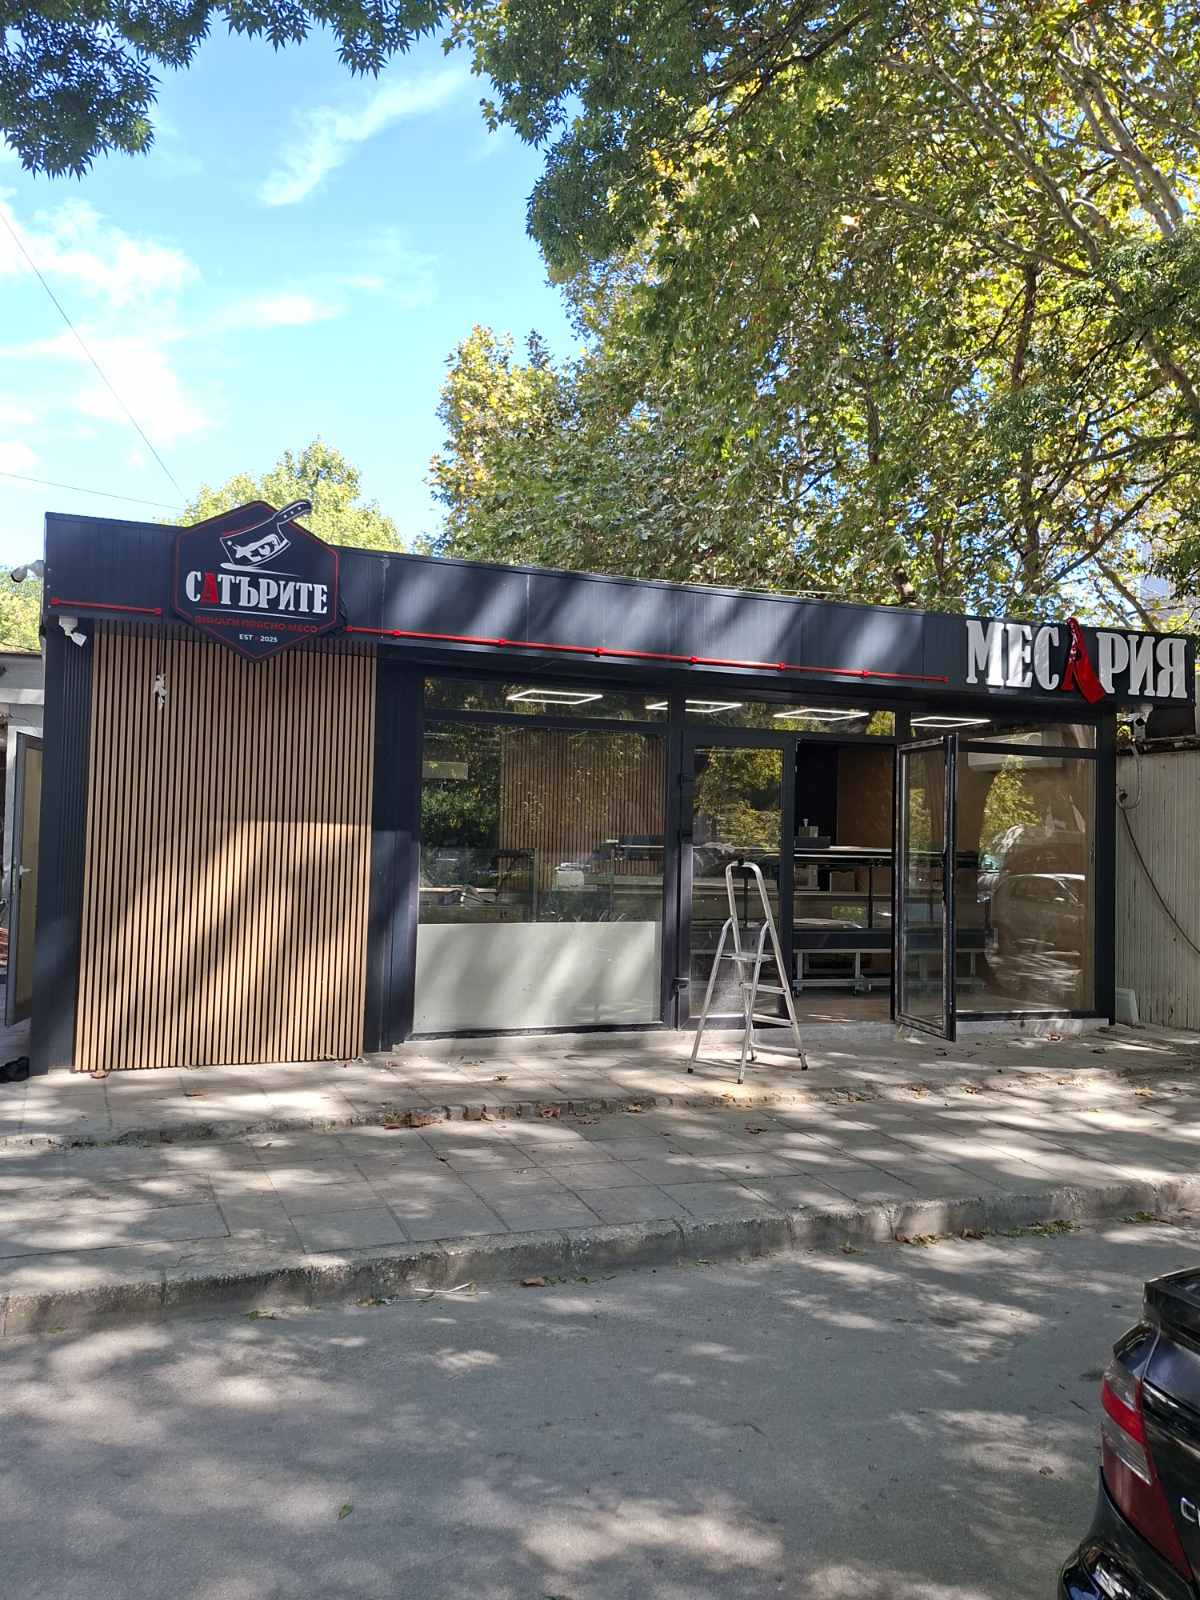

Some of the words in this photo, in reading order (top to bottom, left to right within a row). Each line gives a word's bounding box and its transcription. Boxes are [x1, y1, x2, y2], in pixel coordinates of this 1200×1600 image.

[186, 571, 328, 614] САТЪРИТЕ
[239, 633, 252, 641] EST
[966, 617, 1188, 704] МЕСАРИЯ
